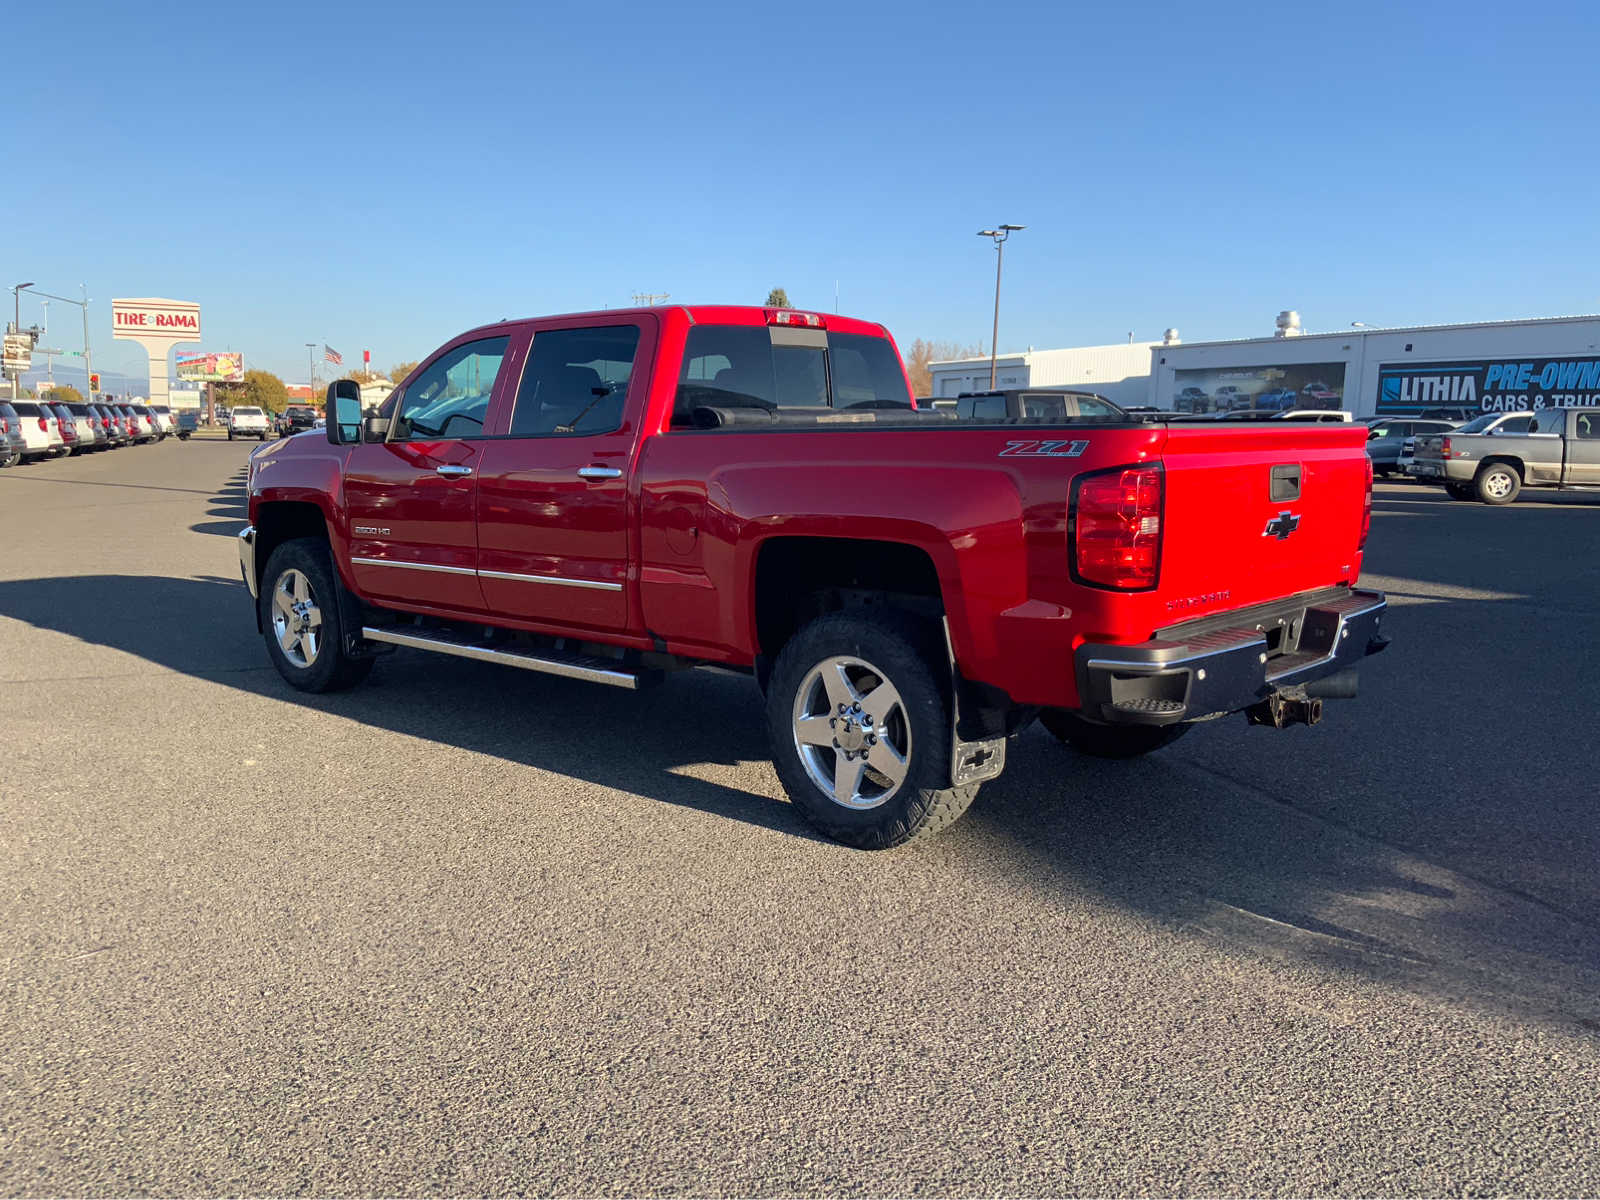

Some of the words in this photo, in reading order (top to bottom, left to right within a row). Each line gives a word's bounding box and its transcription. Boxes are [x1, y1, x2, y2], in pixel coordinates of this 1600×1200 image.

[115, 312, 148, 326] TIRE
[155, 313, 197, 328] RAMA
[1483, 361, 1600, 391] PRE-OWN
[1400, 375, 1477, 401] LITHIA
[1481, 394, 1529, 412] CARS
[1533, 394, 1546, 411] &
[998, 440, 1090, 456] Z71
